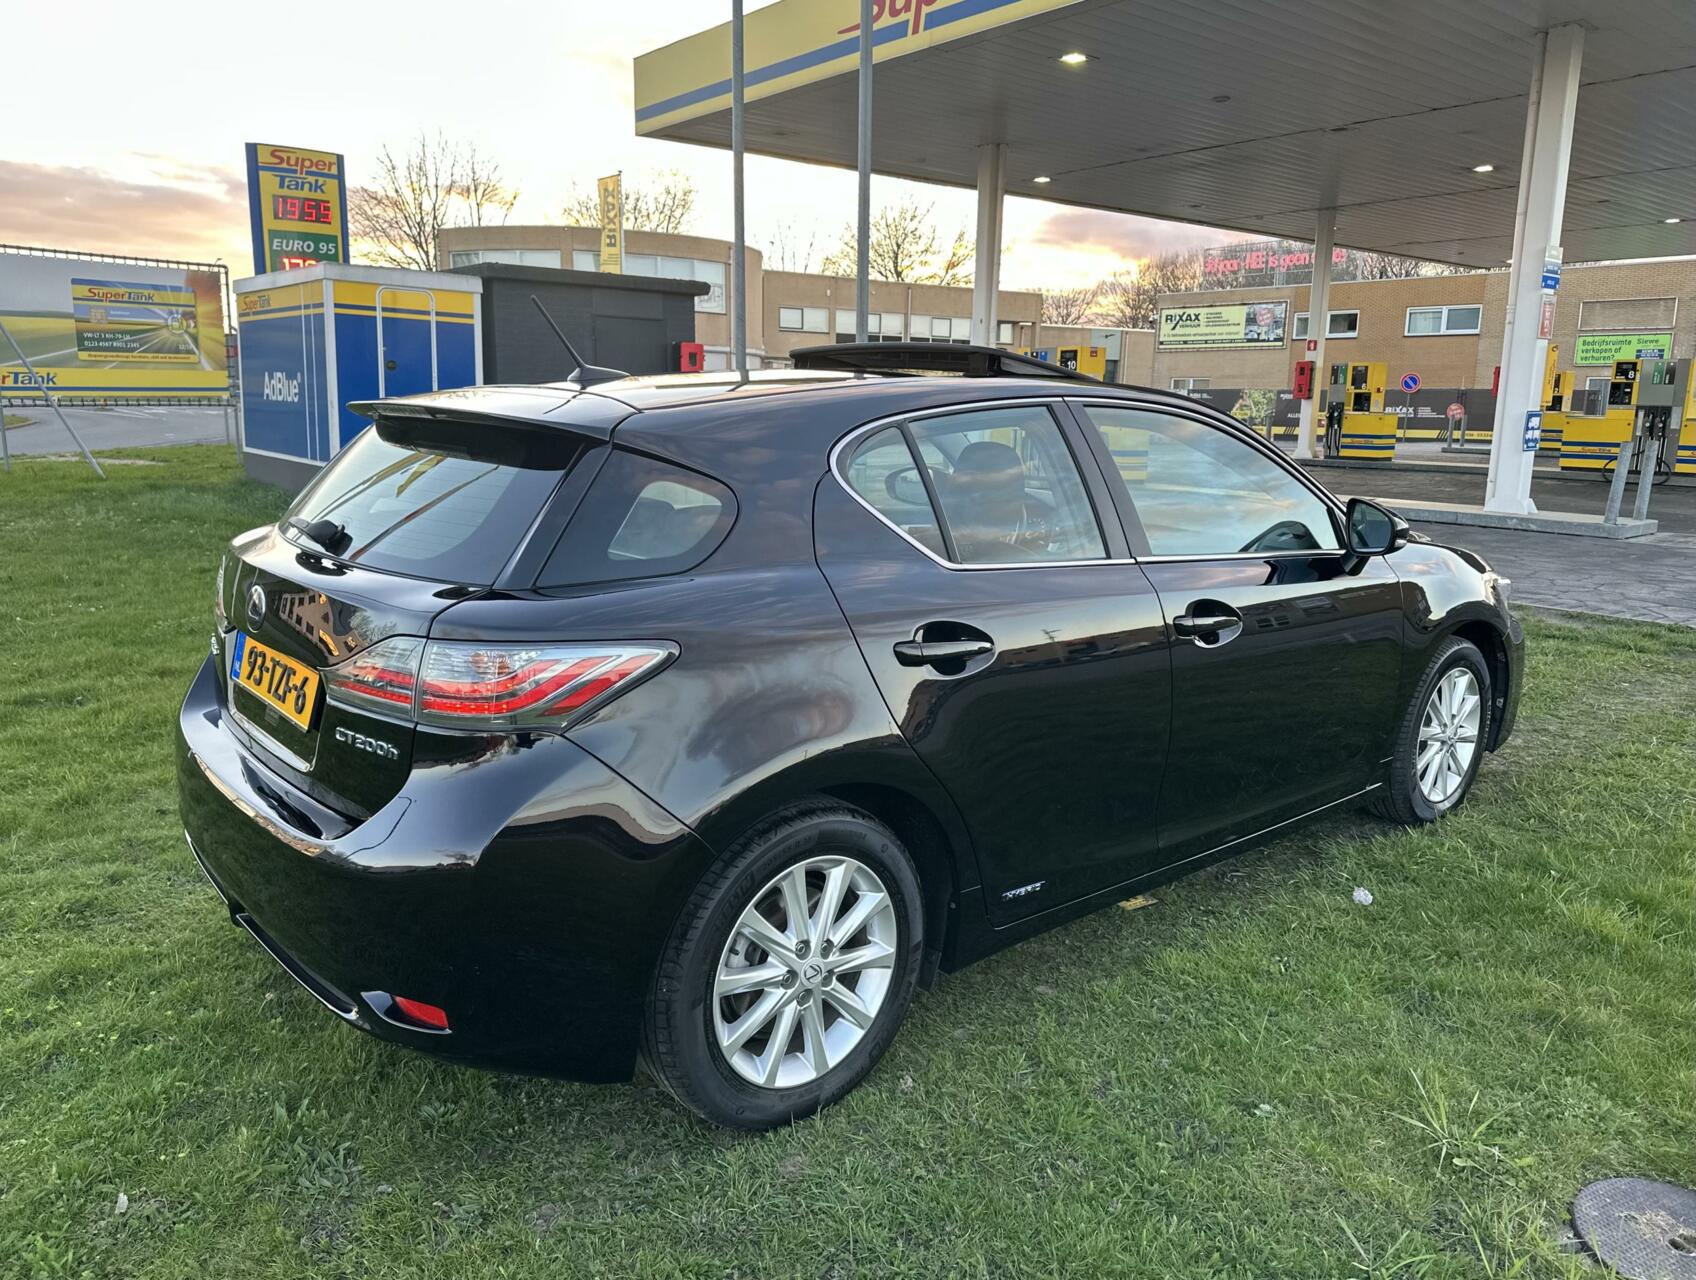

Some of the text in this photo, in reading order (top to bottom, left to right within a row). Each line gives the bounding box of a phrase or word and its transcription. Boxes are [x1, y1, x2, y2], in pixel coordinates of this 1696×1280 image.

[258, 149, 337, 176] Super
[272, 174, 327, 194] Tank
[277, 198, 332, 222] 1955
[272, 239, 336, 254] EURO 95
[83, 287, 155, 304] SuperTank
[1582, 339, 1632, 347] Bedrijfsruimte
[1067, 360, 1077, 370] 10
[1628, 370, 1635, 379] 8
[247, 645, 310, 715] 93-TZF-6
